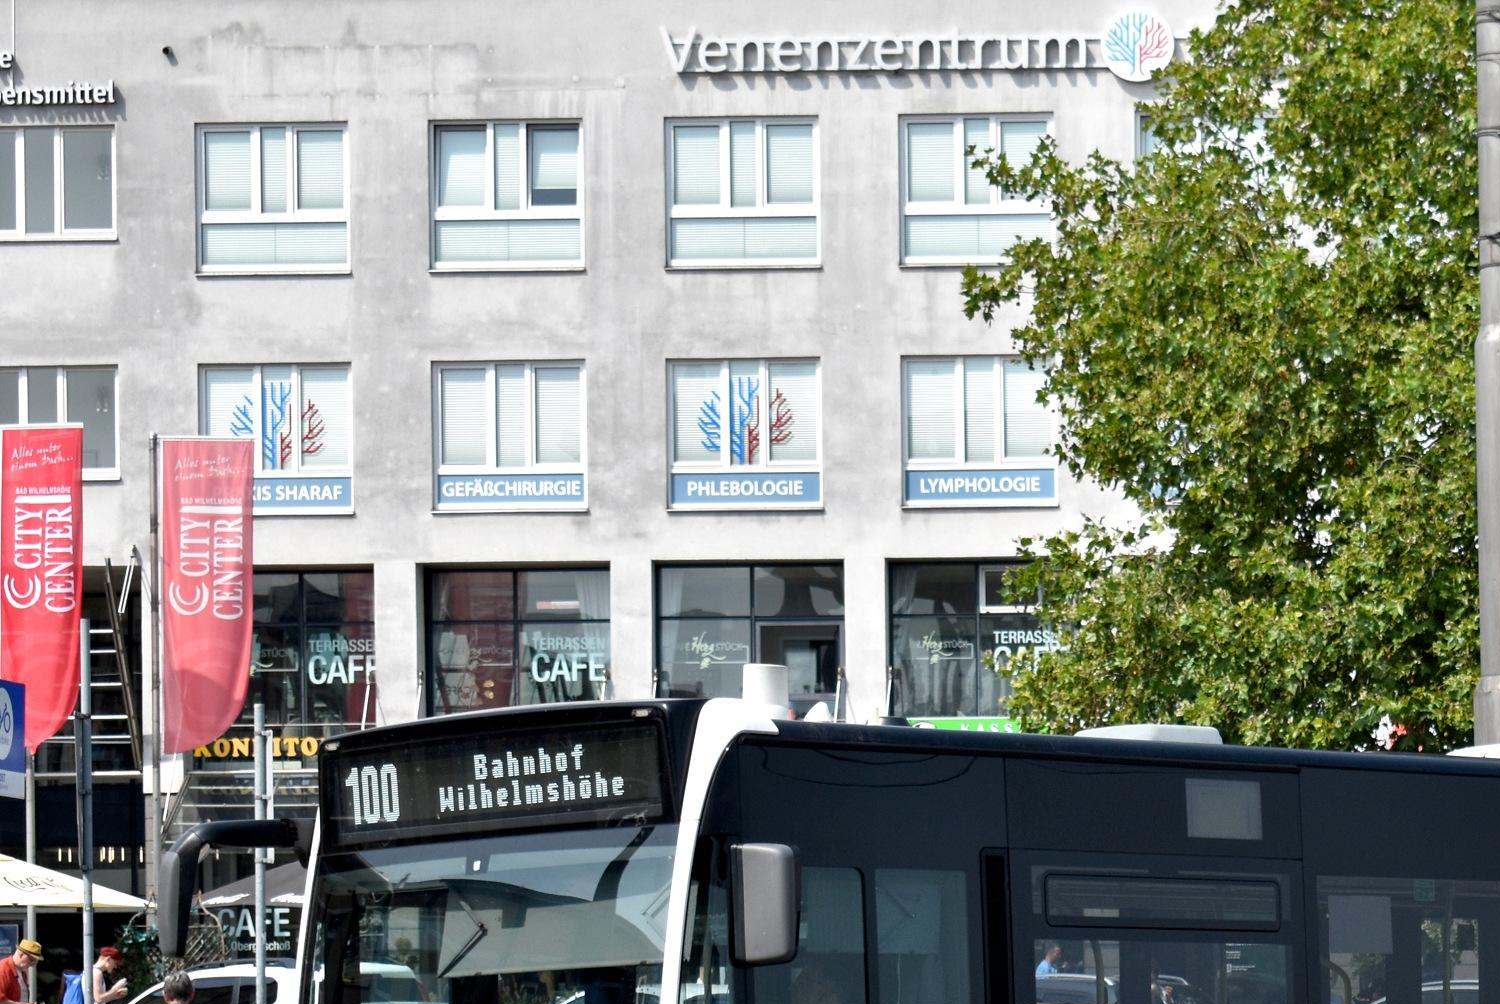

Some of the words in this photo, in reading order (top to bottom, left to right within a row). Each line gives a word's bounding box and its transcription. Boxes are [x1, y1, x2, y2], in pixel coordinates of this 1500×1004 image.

[659, 24, 1086, 73] Venenzentrum
[0, 79, 115, 105] ensmittel
[276, 484, 343, 501] SHARAF
[442, 478, 581, 497] GEFÄßCHIRURGIE
[687, 480, 804, 496] PHLEBOLOGIE
[920, 476, 1041, 494] LYMPHOLOGIE
[14, 506, 43, 570] CITY
[179, 516, 211, 578] CITY
[44, 505, 76, 613] CENTER
[212, 515, 244, 621] CENTER
[308, 639, 375, 653] TERRASSE
[532, 636, 605, 651] TERRASSEN
[993, 630, 1054, 645] TERRASS
[531, 652, 606, 683] CAFE
[193, 736, 324, 758] KONITO
[345, 763, 401, 826] 100
[473, 744, 584, 780] Bahnhof
[439, 771, 625, 813] Wilhelmshöhe
[230, 940, 291, 953] Obergschoß
